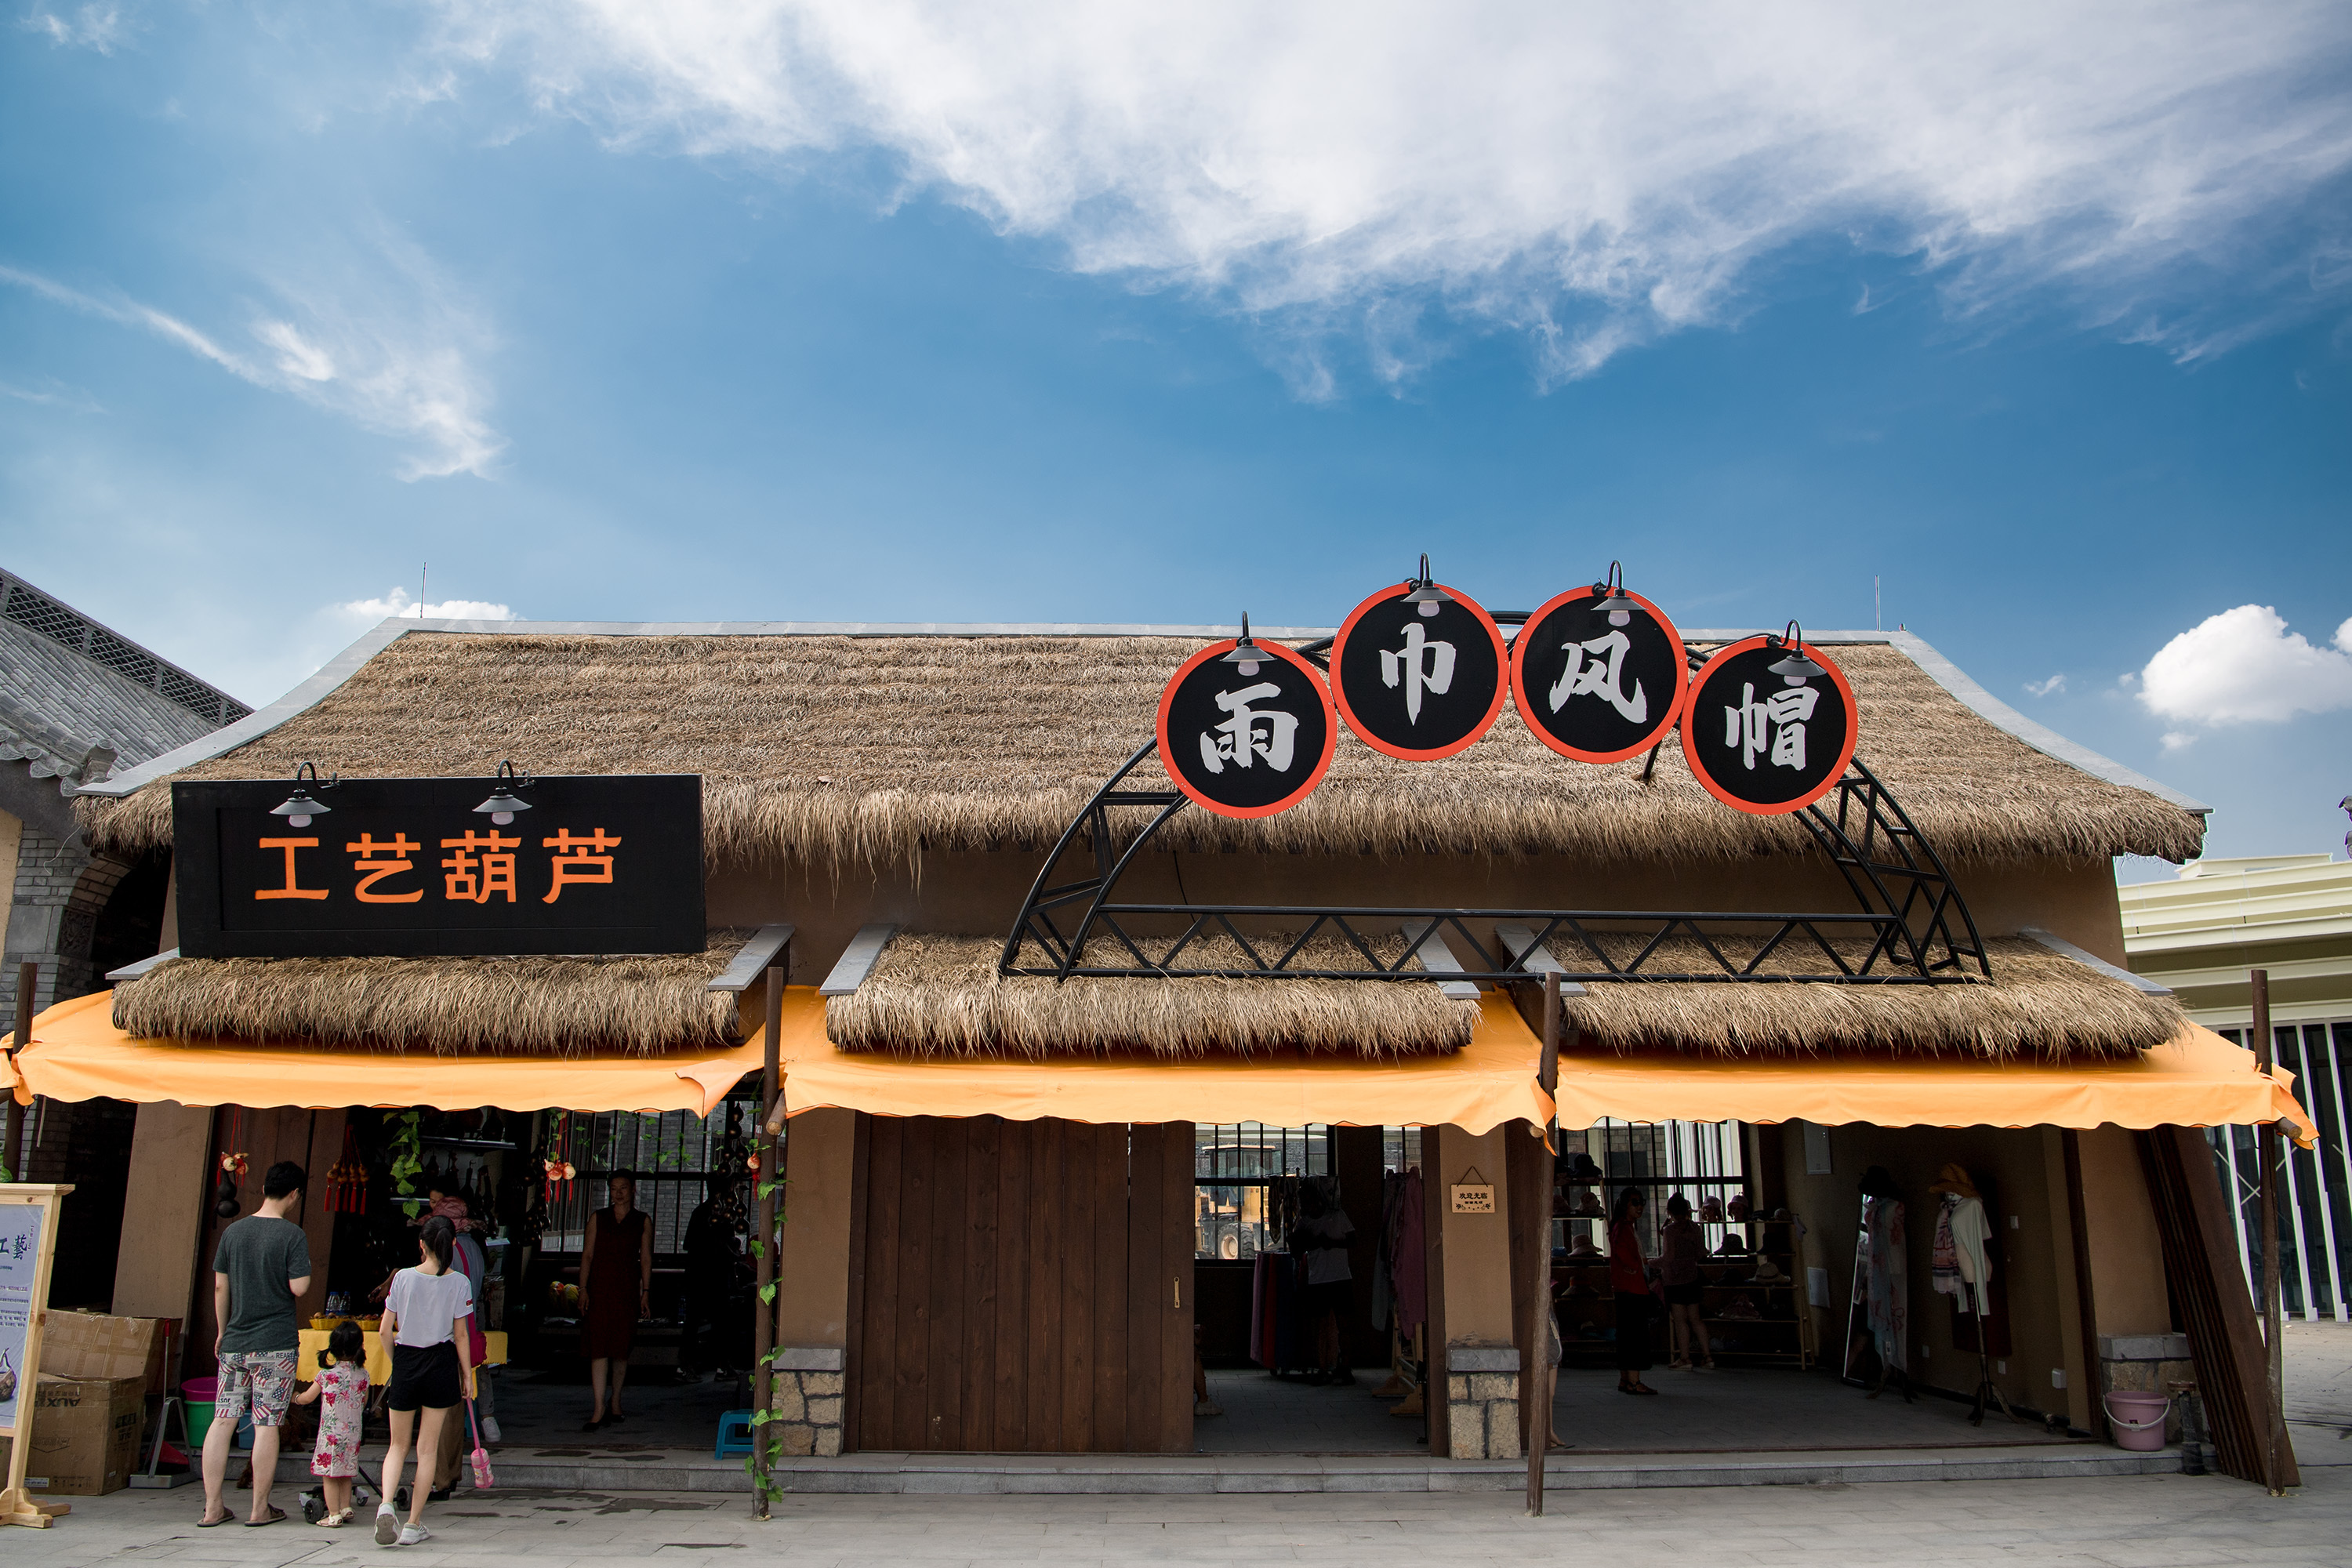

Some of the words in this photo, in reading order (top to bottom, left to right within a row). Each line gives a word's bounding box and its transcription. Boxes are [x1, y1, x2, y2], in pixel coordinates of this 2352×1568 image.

[1200, 623, 1820, 774] 雨巾风帽
[255, 828, 622, 904] 工艺葫芦
[47, 1398, 81, 1407] AUX
